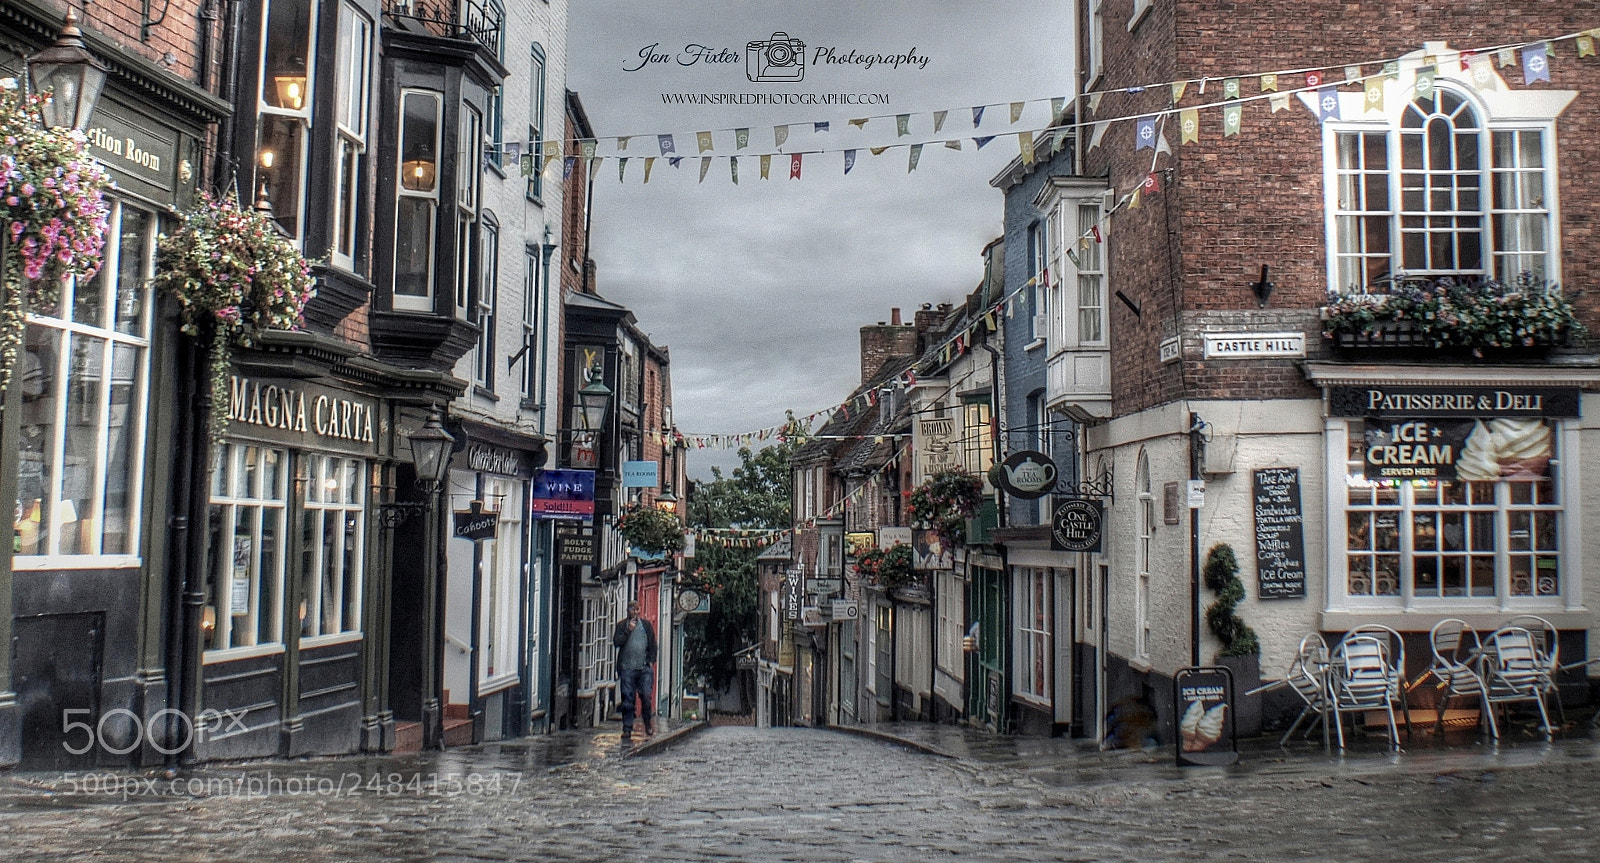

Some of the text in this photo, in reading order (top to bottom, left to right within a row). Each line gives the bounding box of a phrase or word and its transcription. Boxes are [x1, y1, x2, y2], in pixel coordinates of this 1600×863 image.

[125, 138, 160, 171] Room
[1216, 342, 1260, 351] CASTLE
[1367, 390, 1543, 410] PATISSERIE & DELI
[227, 375, 374, 443] MAGNA CARTA
[1391, 422, 1428, 443] ICE
[1366, 444, 1453, 465] CREAM
[1381, 467, 1437, 476] SERVED HERE
[1067, 511, 1087, 521] ONE
[1060, 519, 1093, 529] CASTLE
[1066, 528, 1087, 538] HILL
[563, 546, 592, 554] FUDGE
[788, 578, 799, 620] WINES
